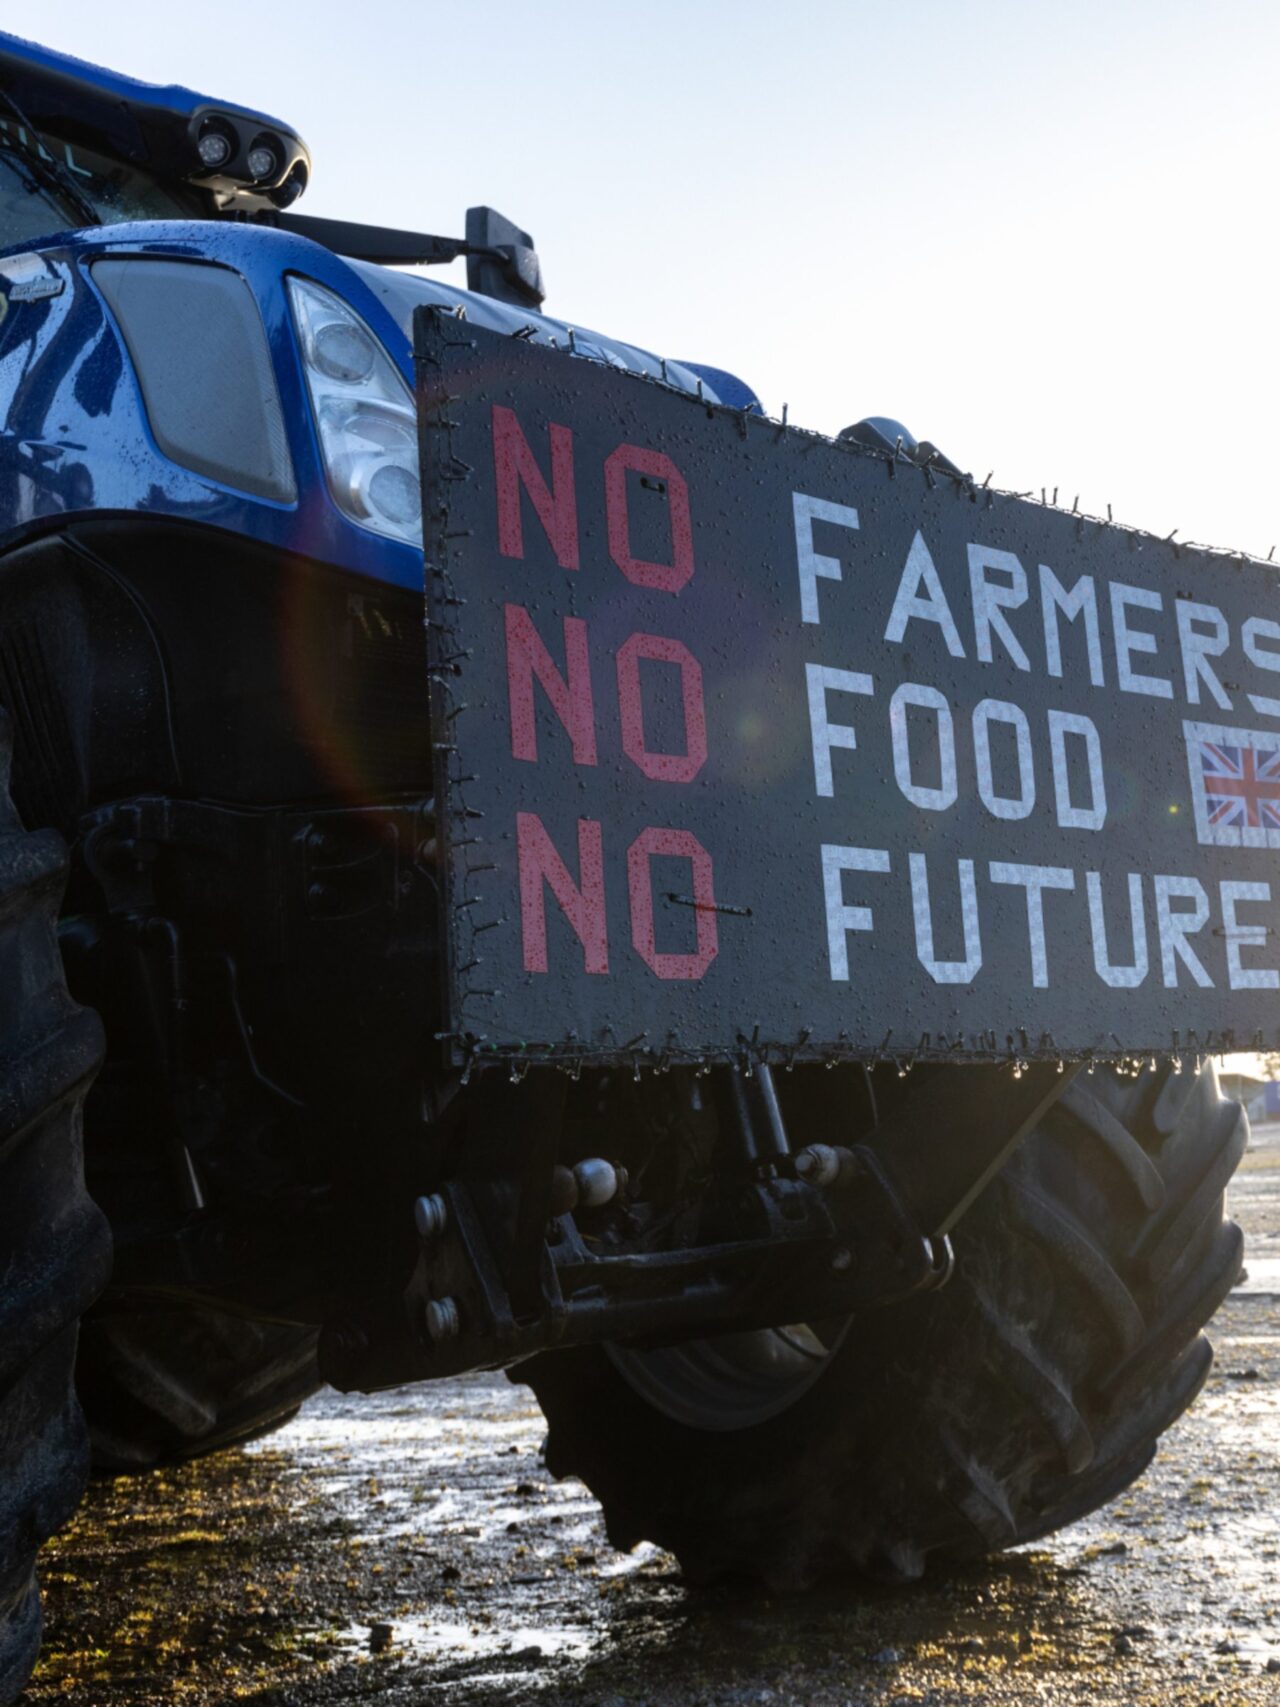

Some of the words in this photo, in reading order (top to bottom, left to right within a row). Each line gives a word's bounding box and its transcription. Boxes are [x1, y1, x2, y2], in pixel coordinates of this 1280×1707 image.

[492, 405, 695, 593] NO
[504, 603, 708, 783] NO
[805, 663, 1107, 831] FOOD
[517, 812, 719, 980] NO
